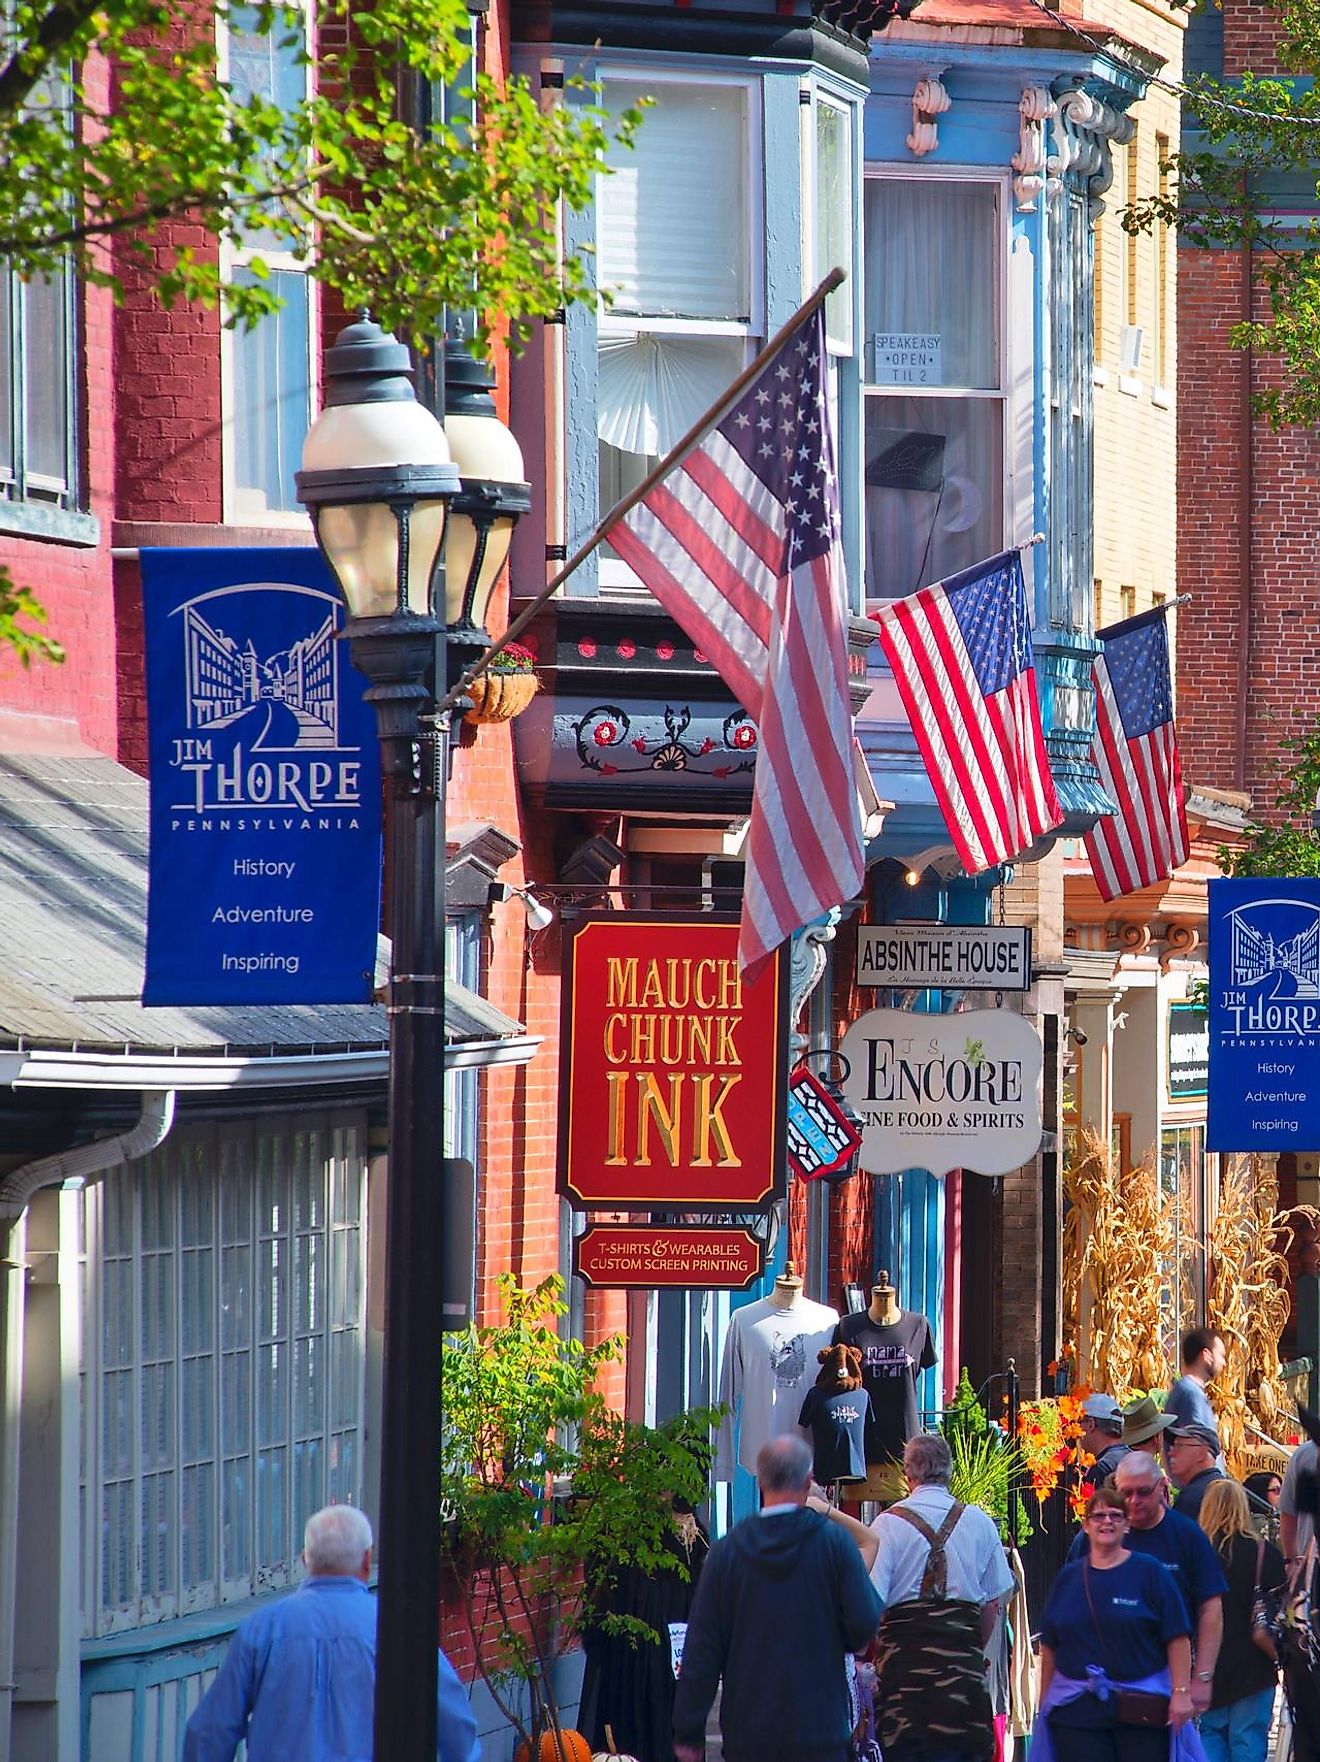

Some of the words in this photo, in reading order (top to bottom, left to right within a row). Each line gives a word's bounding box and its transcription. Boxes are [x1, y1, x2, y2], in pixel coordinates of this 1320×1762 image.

[877, 336, 941, 349] SPEAKEASY
[892, 353, 926, 366] OPEN
[893, 369, 913, 382] TIL
[920, 370, 927, 382] 2
[169, 739, 214, 766] JIM
[180, 741, 361, 814] THORPE
[172, 819, 360, 831] PENNSYLVANIA
[233, 859, 296, 878] History
[211, 906, 314, 923] Adventure
[222, 953, 300, 974] Inspiring
[861, 940, 953, 972] ABSINTHE
[957, 941, 1020, 974] HOUSE
[605, 957, 744, 1009] MAUCH
[1220, 991, 1246, 1009] JIM
[604, 1013, 743, 1065] CHUNK
[861, 1038, 1023, 1105] ENCORE
[1257, 1062, 1296, 1075] History
[1245, 1091, 1307, 1102] Adventure
[604, 1071, 743, 1167] INK
[898, 1111, 943, 1128] FOOD
[947, 1112, 959, 1128] &
[963, 1112, 1024, 1129] SPIRITS
[1252, 1119, 1299, 1132] Inspiring
[599, 1243, 651, 1256] T-SHIRTS
[652, 1239, 669, 1257] &
[669, 1244, 740, 1256] WEARABLES
[590, 1258, 642, 1270] CUSTOM
[644, 1258, 688, 1271] SCREEN
[692, 1259, 748, 1272] PRINTING
